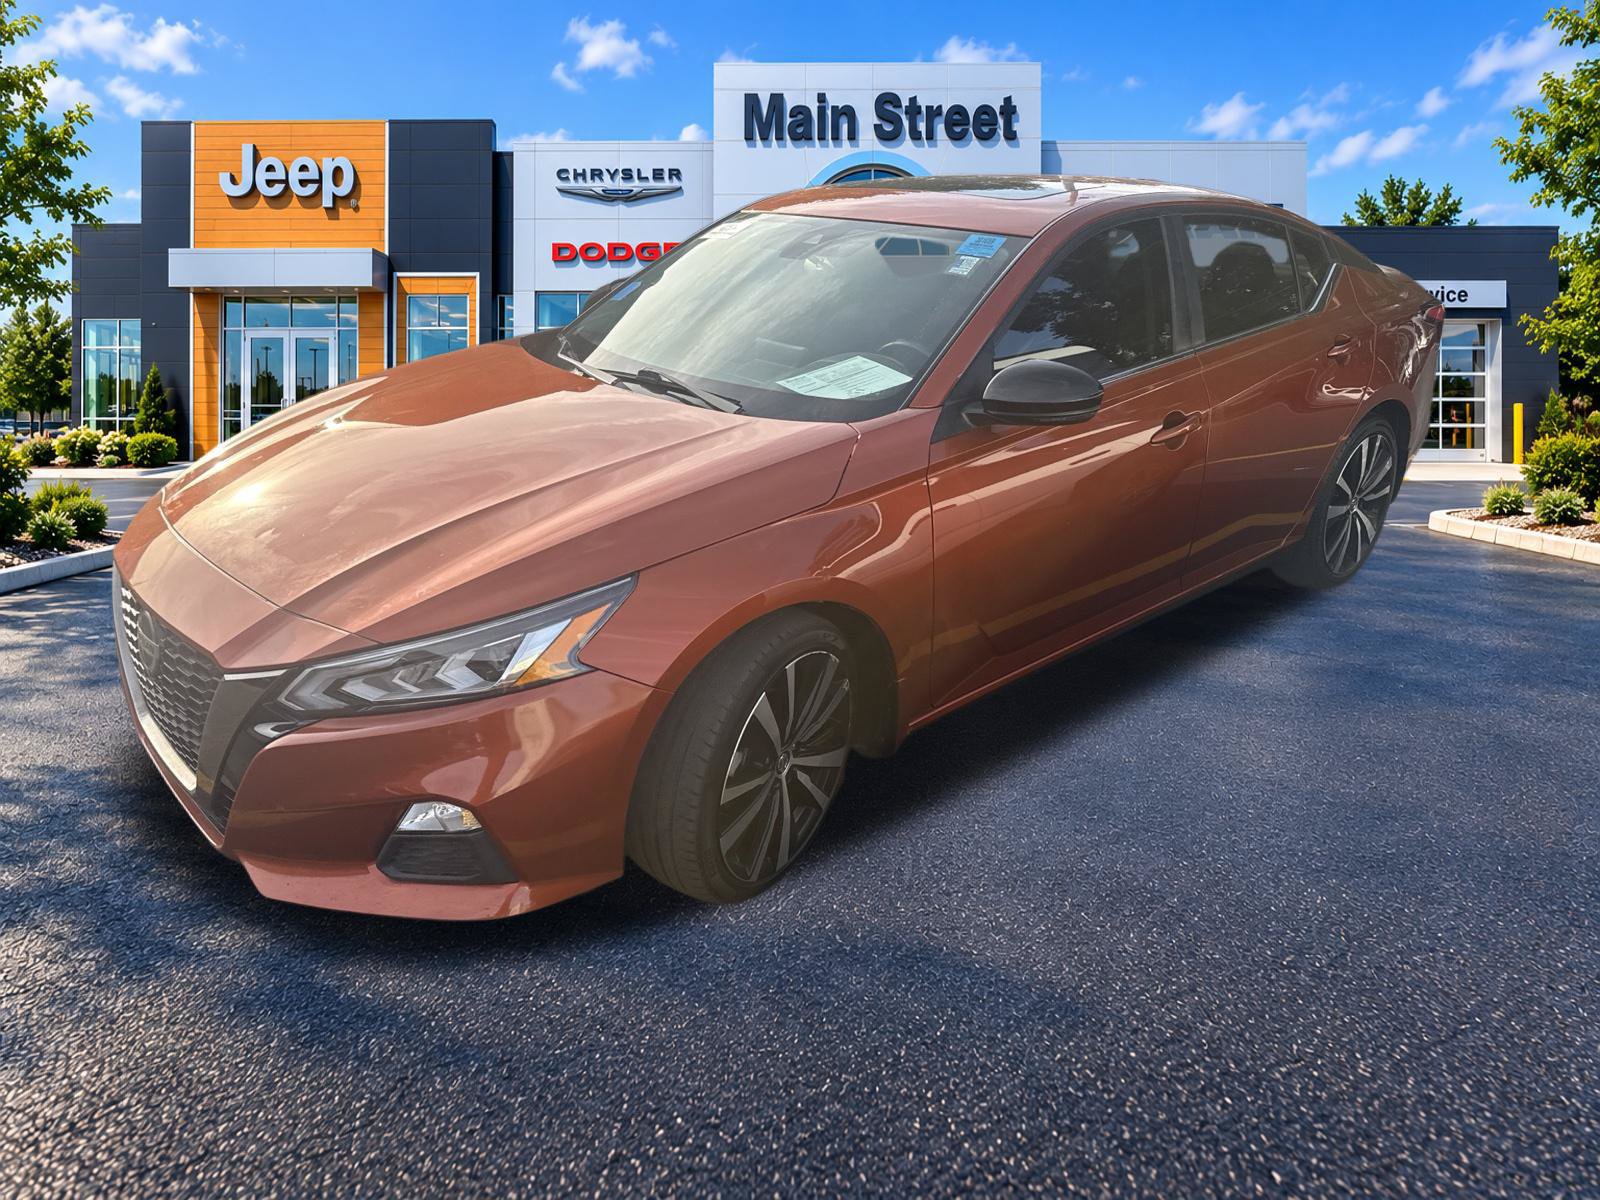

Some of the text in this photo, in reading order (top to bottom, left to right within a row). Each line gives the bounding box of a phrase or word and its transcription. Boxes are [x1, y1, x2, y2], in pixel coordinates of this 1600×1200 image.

[743, 92, 1017, 141] Main Street
[218, 143, 355, 208] Jeep
[556, 168, 682, 182] CHRYSLER
[1425, 285, 1469, 303] vice
